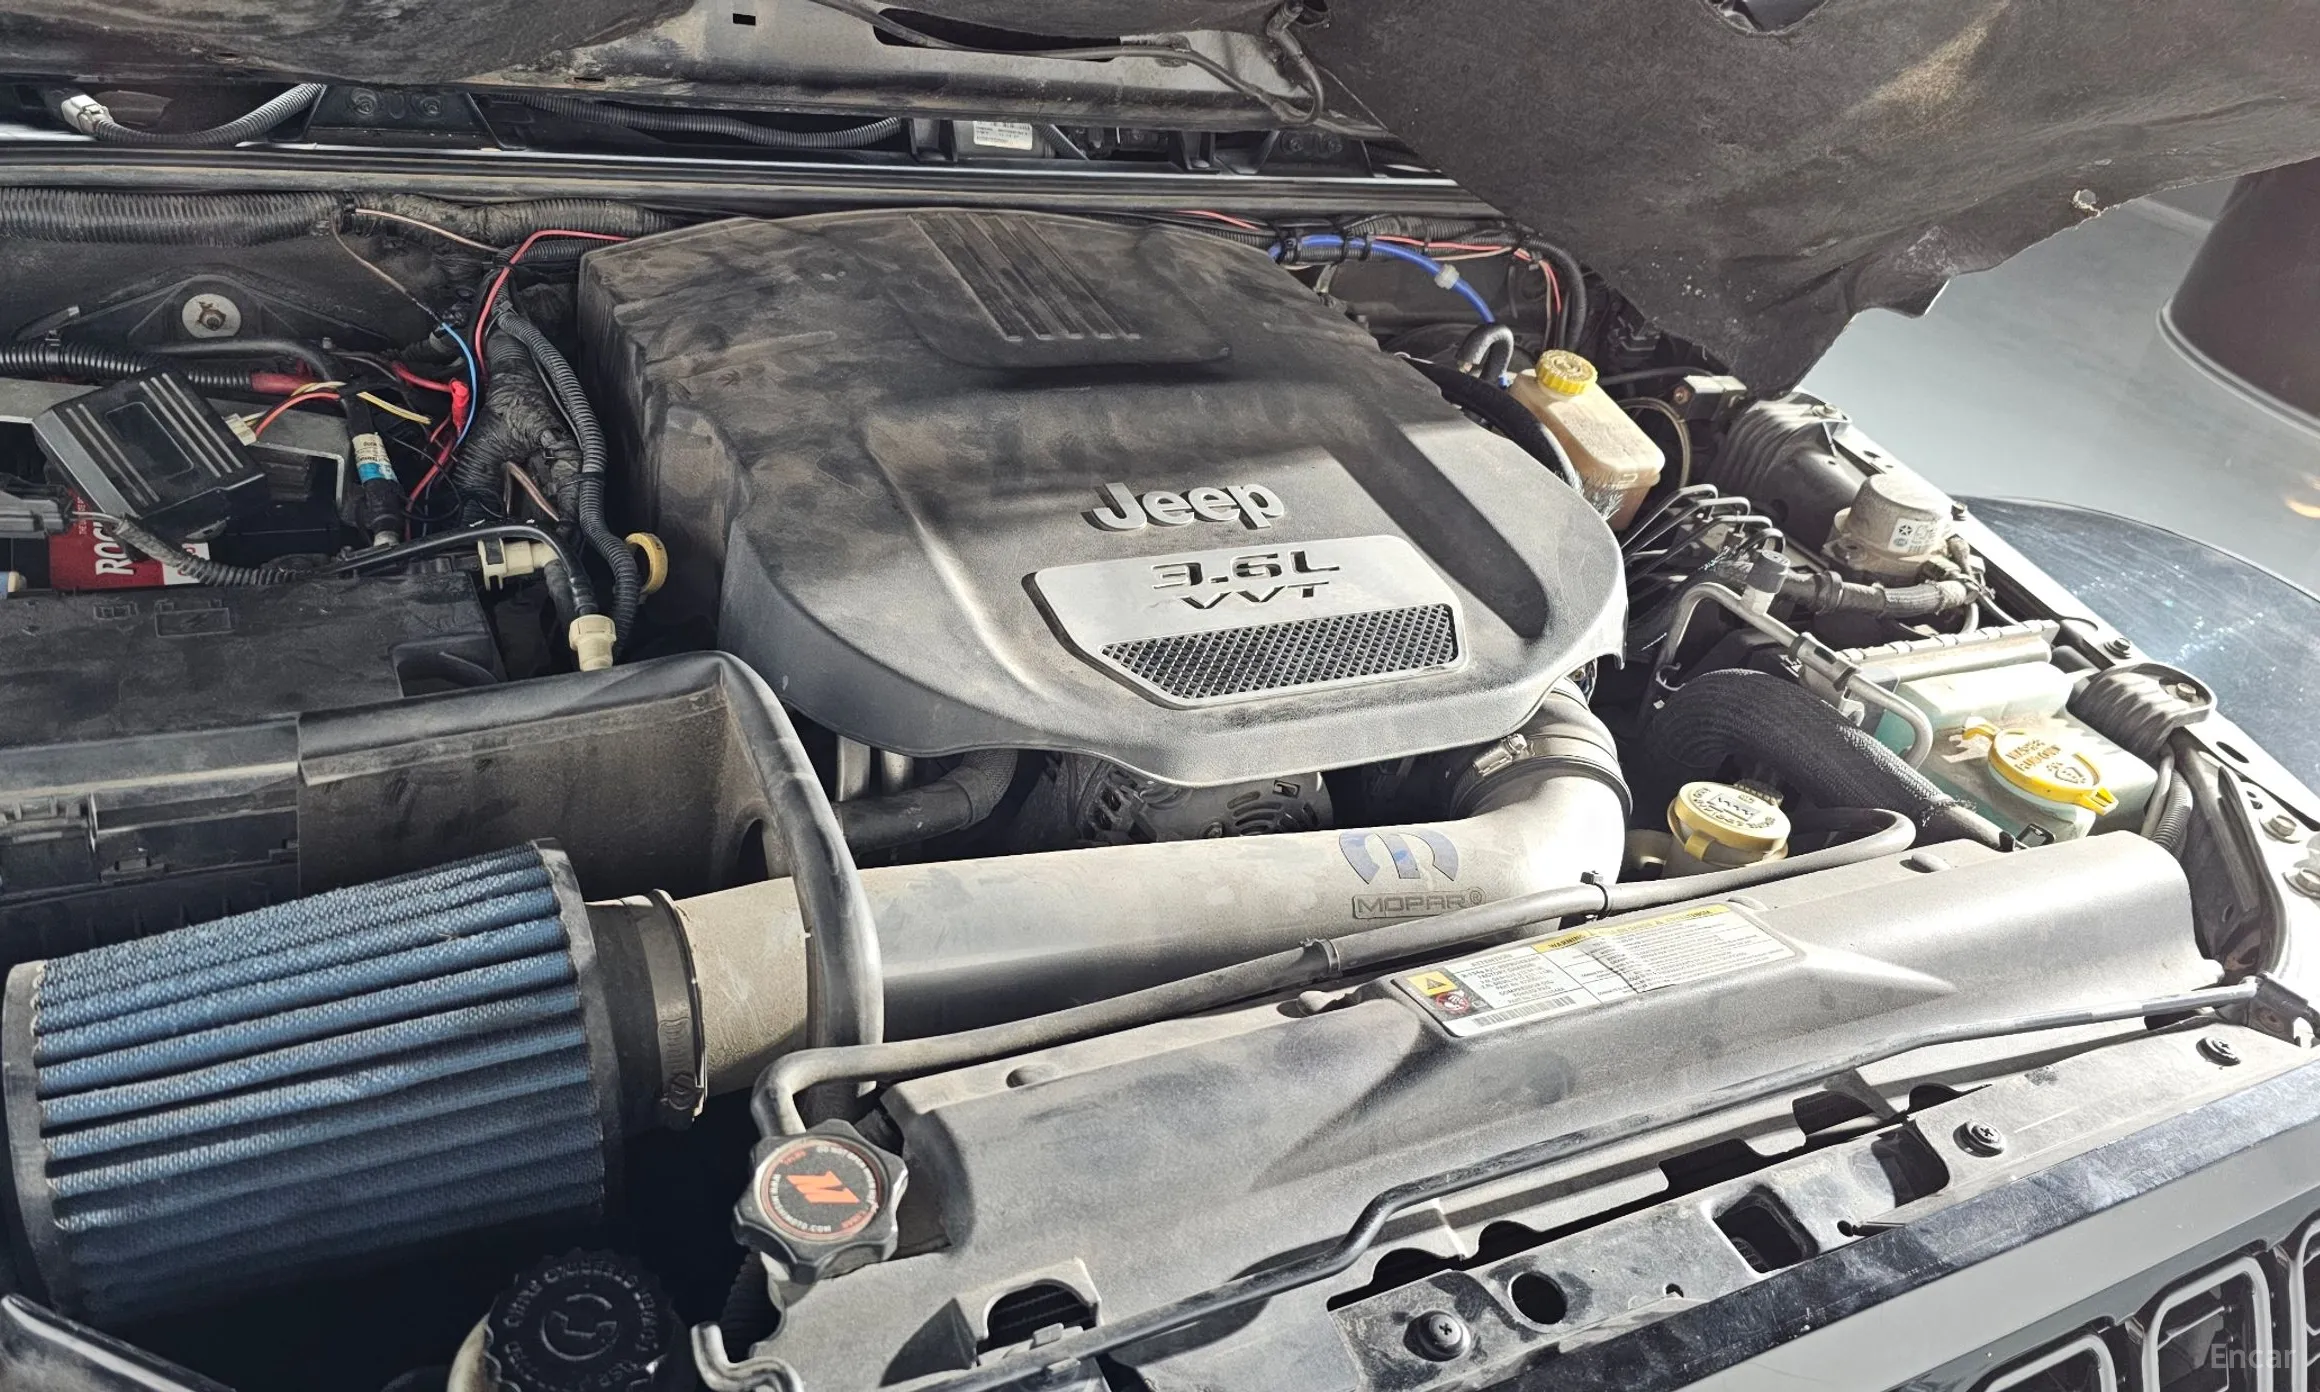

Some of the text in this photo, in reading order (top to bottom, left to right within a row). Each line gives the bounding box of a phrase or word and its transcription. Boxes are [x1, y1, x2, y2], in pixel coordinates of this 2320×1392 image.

[1083, 482, 1285, 530] Jeep
[1150, 550, 1341, 590] 3.6L
[1178, 581, 1330, 610] VVT
